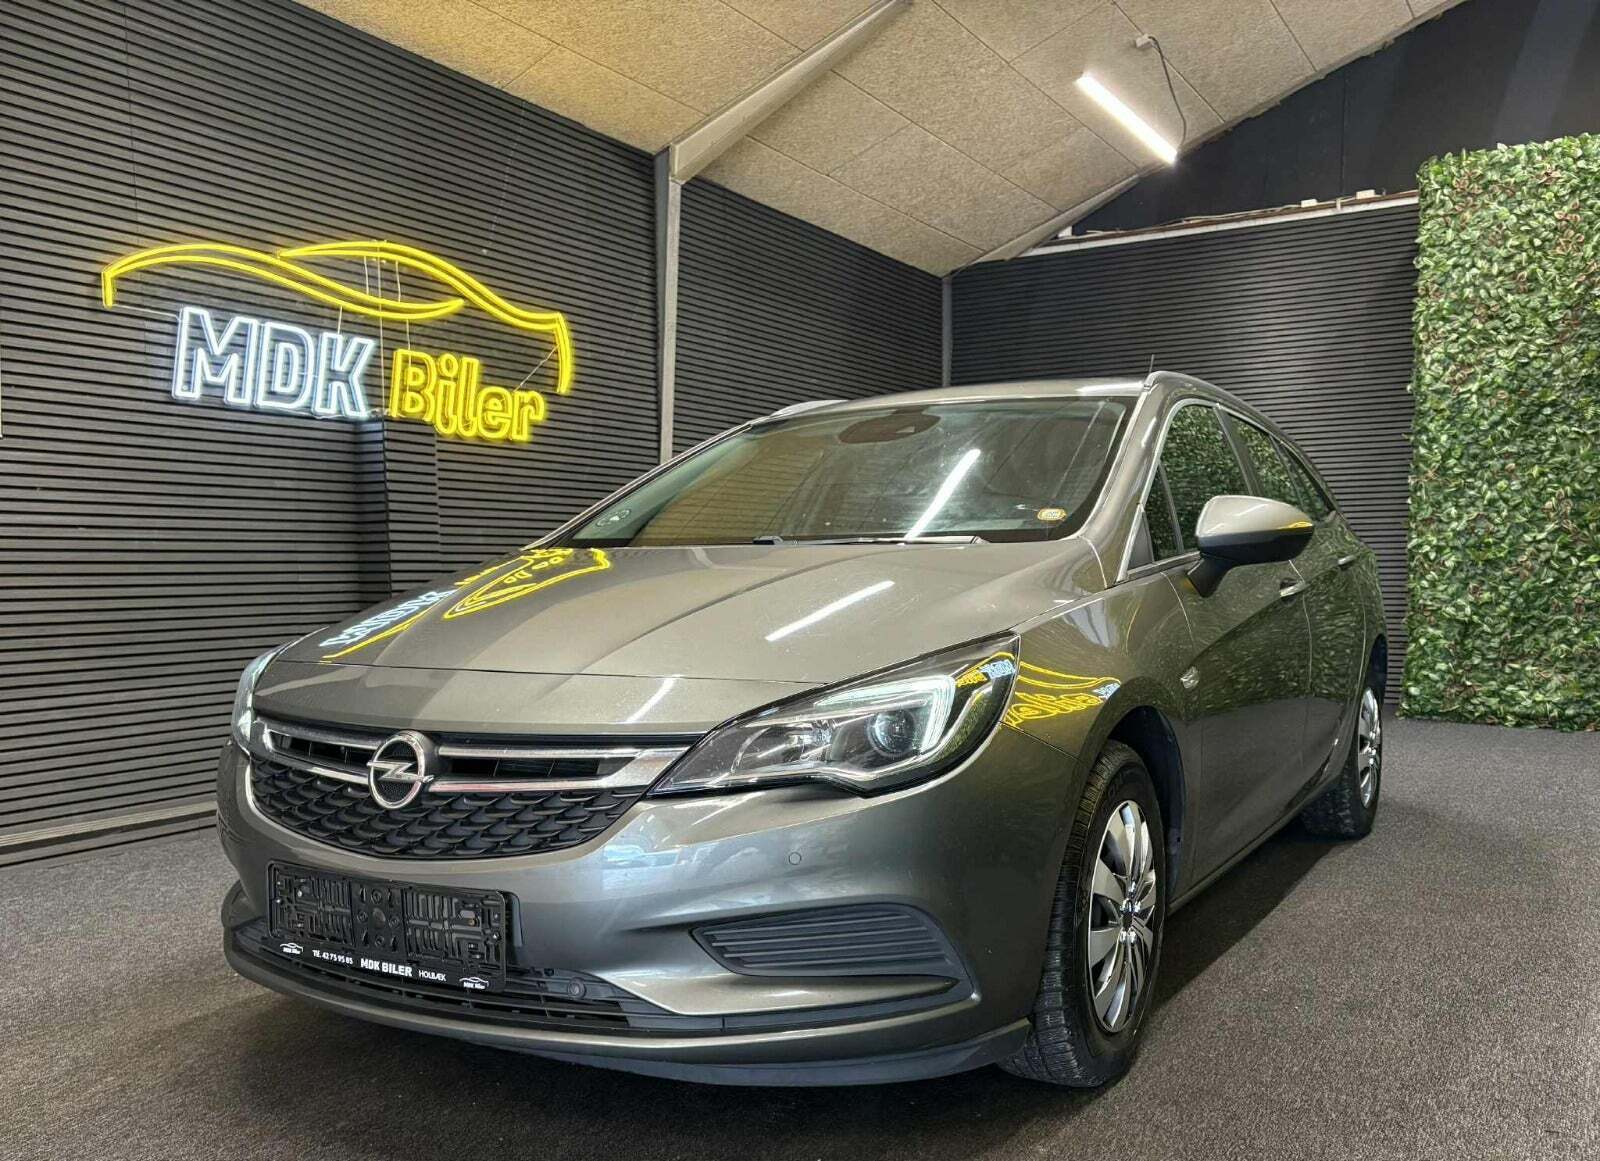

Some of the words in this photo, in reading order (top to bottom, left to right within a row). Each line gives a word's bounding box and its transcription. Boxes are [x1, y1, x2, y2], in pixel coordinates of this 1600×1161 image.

[172, 305, 375, 418] MDK
[391, 347, 545, 441] Biler
[360, 958, 380, 971] MDK
[381, 962, 412, 977] BILER
